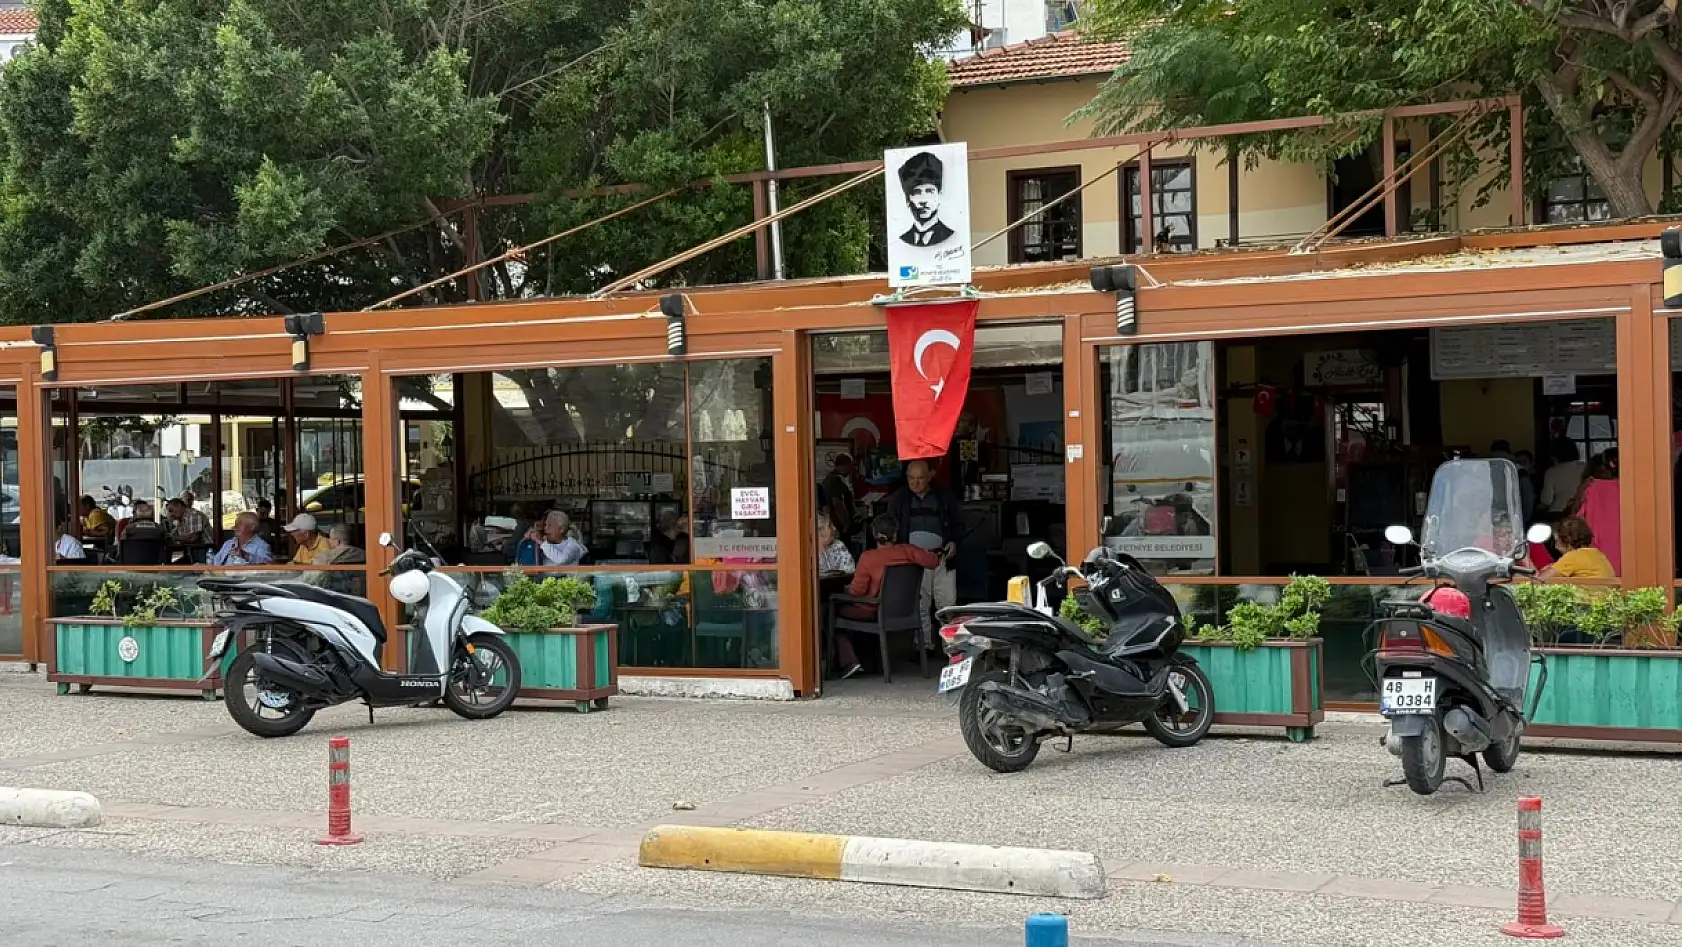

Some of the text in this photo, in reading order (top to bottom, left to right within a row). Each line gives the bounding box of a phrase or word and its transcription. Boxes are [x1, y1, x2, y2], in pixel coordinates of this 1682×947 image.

[1385, 680, 1433, 693] 48 H
[1397, 694, 1431, 707] 0384
